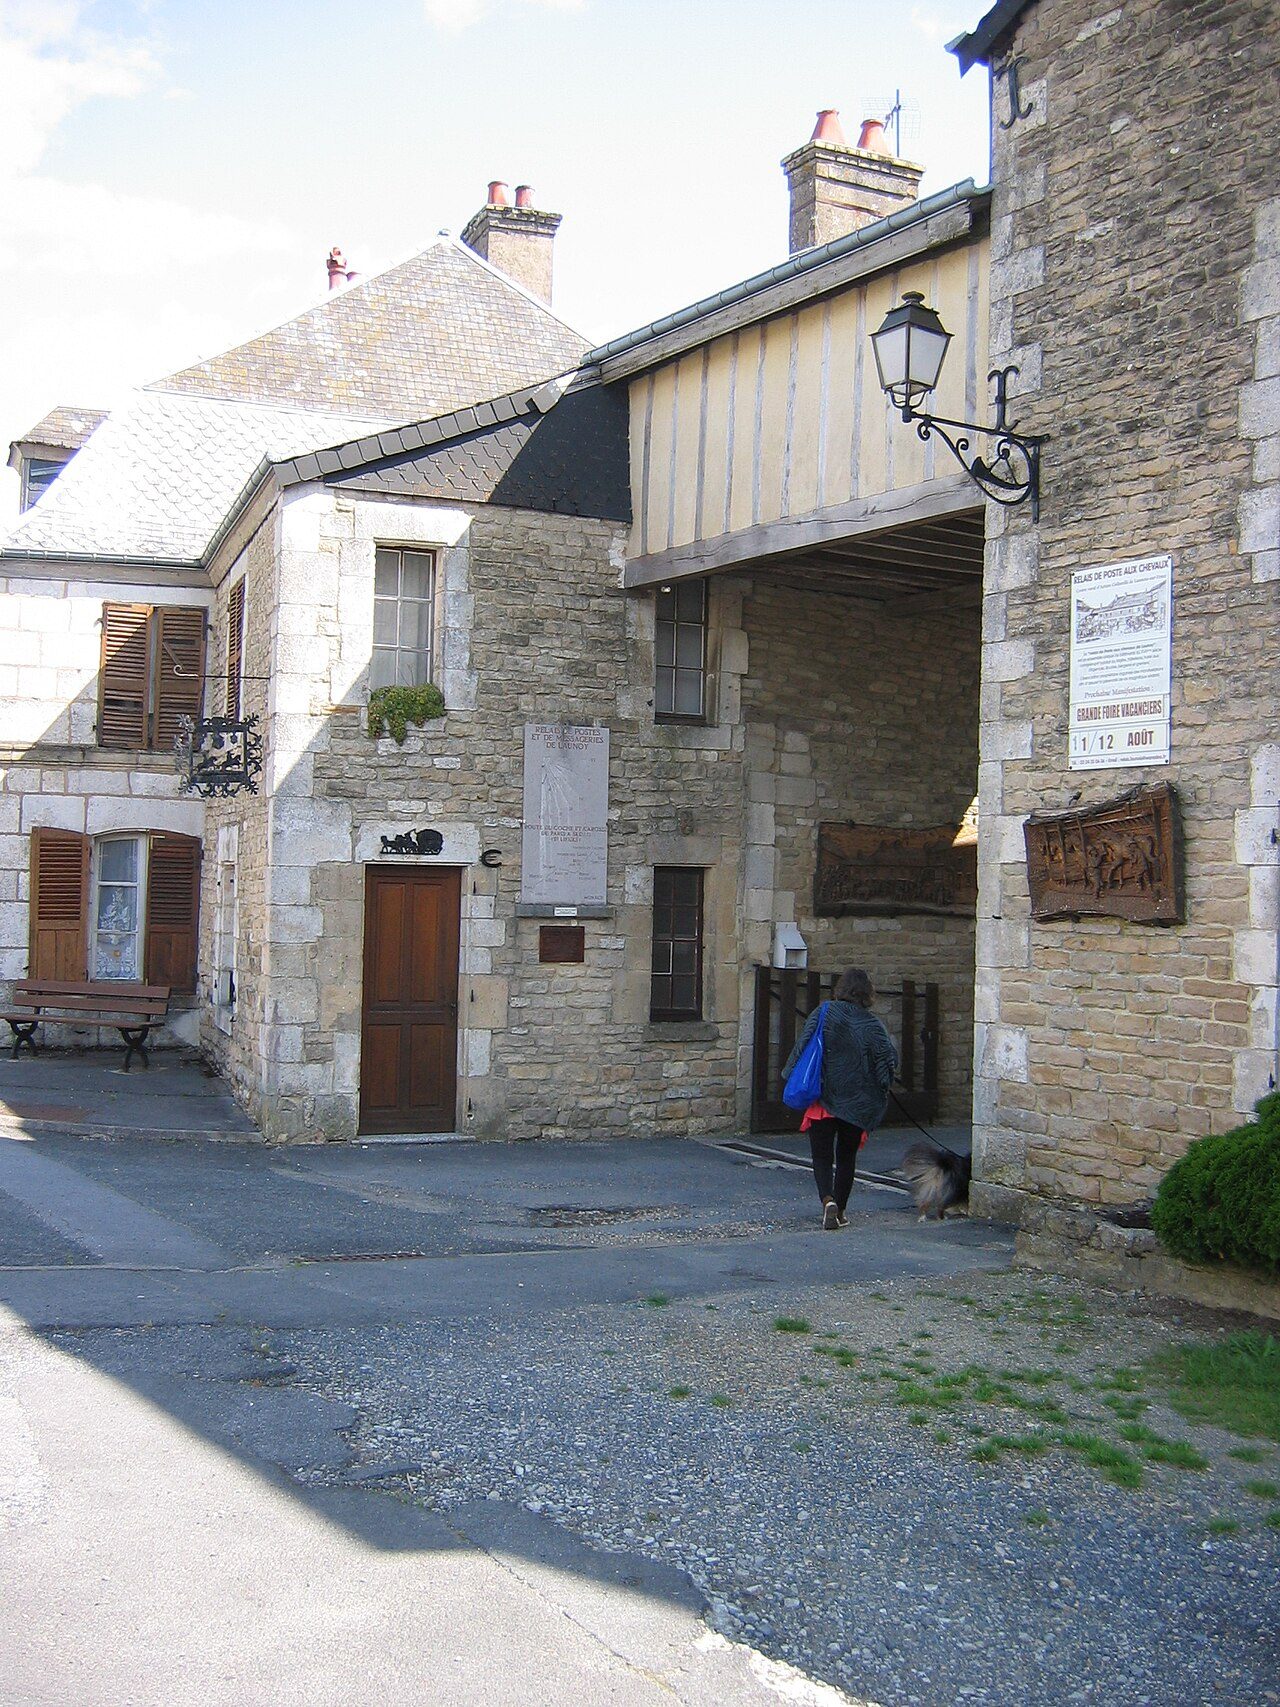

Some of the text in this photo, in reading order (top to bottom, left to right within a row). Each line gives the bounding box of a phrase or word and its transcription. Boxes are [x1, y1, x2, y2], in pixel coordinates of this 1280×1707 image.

[1074, 560, 1169, 585] RELAIS DE POSTE AUX CHEVAUX
[1076, 700, 1162, 722] GRANDE FOIRE VACANCIERS
[535, 726, 560, 734] RELAIS
[574, 728, 601, 736] POSTES
[1127, 729, 1154, 747] AOÛT
[546, 741, 589, 750] DE LAUNOY
[556, 735, 604, 744] MESSAGERIES
